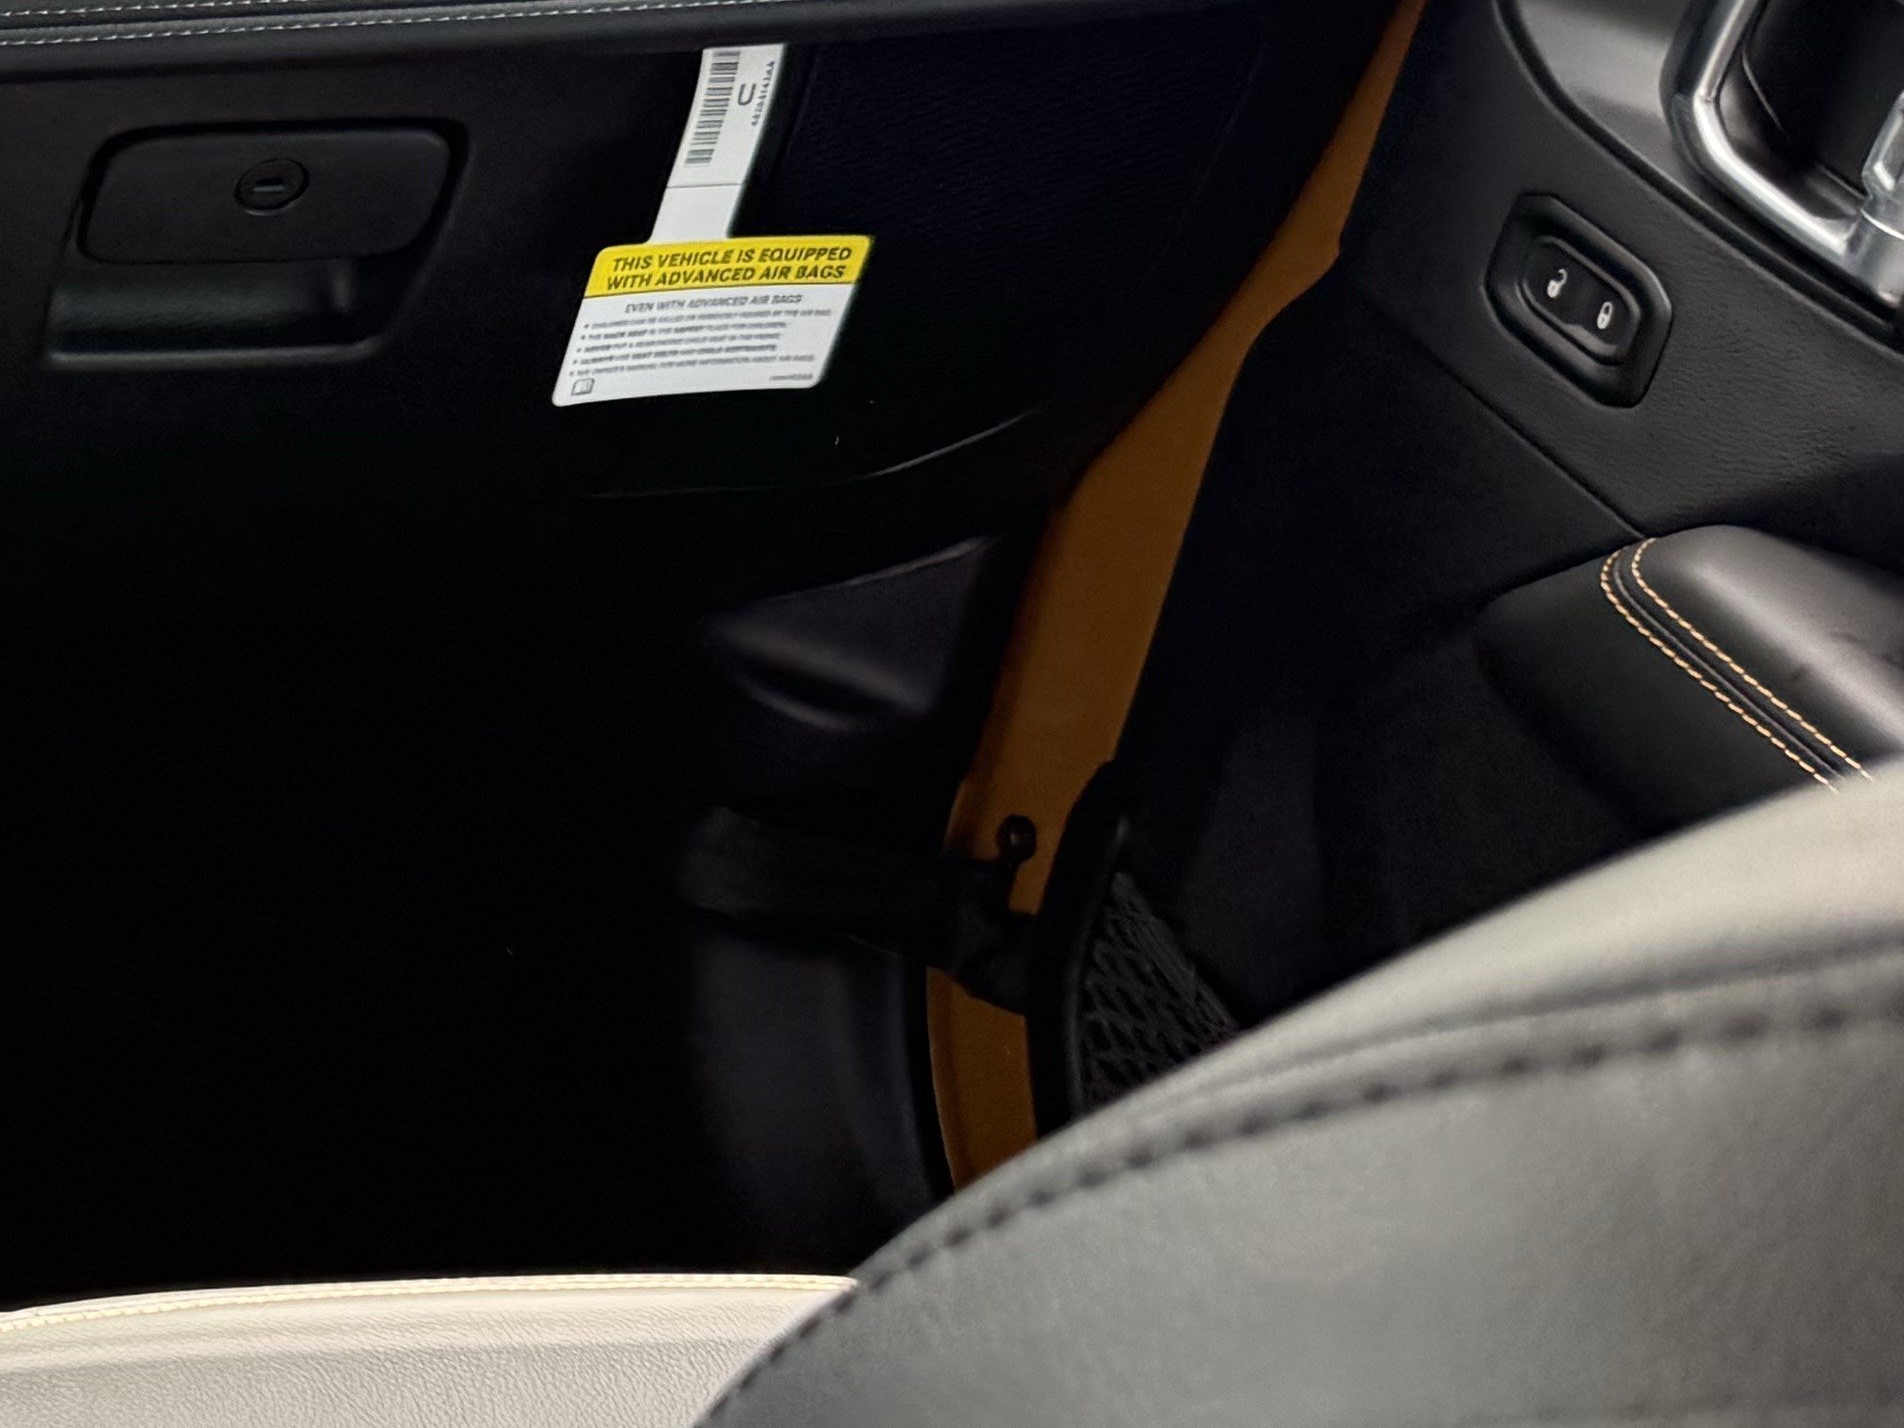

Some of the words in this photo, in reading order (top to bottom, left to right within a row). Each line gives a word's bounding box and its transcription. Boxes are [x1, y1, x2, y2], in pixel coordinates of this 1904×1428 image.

[738, 82, 757, 106] U
[612, 254, 653, 272] THIS
[657, 248, 736, 269] VEHICLE
[737, 248, 756, 264] IS
[757, 246, 853, 264] EQUIPPED
[606, 272, 653, 291] WITH
[654, 266, 756, 288] ADVANCED
[758, 266, 793, 281] AIR
[794, 263, 847, 280] BAGS
[624, 302, 653, 315] EVEN
[685, 295, 750, 310] ADVANCED
